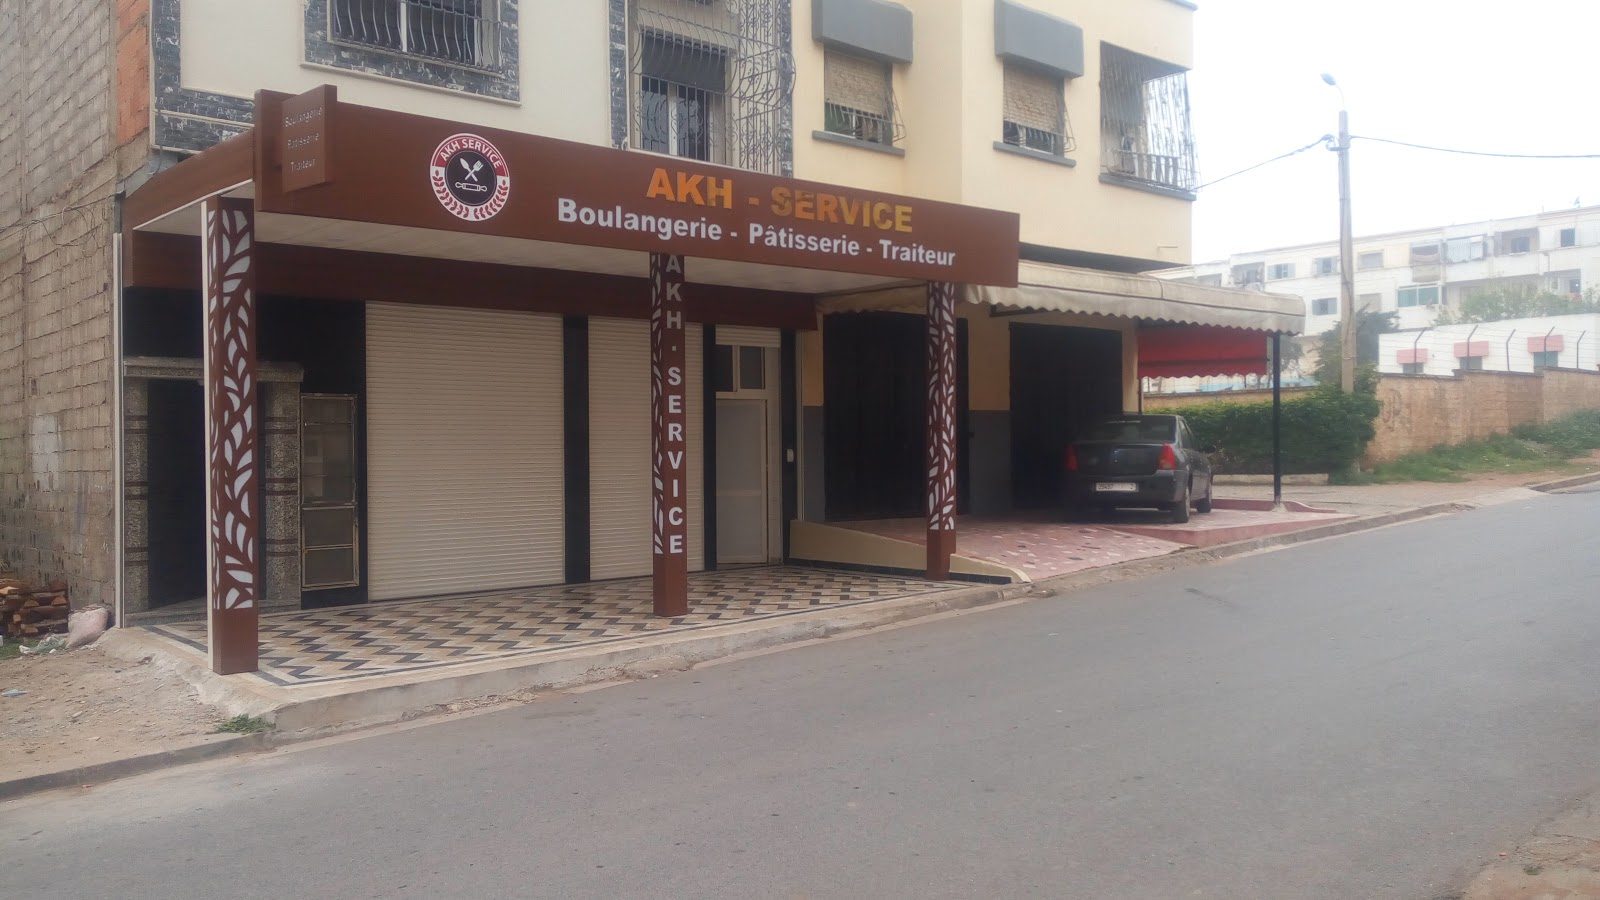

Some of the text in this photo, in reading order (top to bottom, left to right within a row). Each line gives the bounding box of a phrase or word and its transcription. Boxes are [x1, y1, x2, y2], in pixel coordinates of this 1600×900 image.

[440, 138, 504, 169] AKH SERVICE
[558, 197, 722, 241] Boulangerie
[749, 223, 860, 256] Pâtisserie
[879, 239, 956, 266] Traiteur
[646, 167, 732, 209] AKH
[770, 186, 913, 233] SERVICE
[665, 254, 682, 330] AKH
[667, 366, 684, 554] SERVICE
